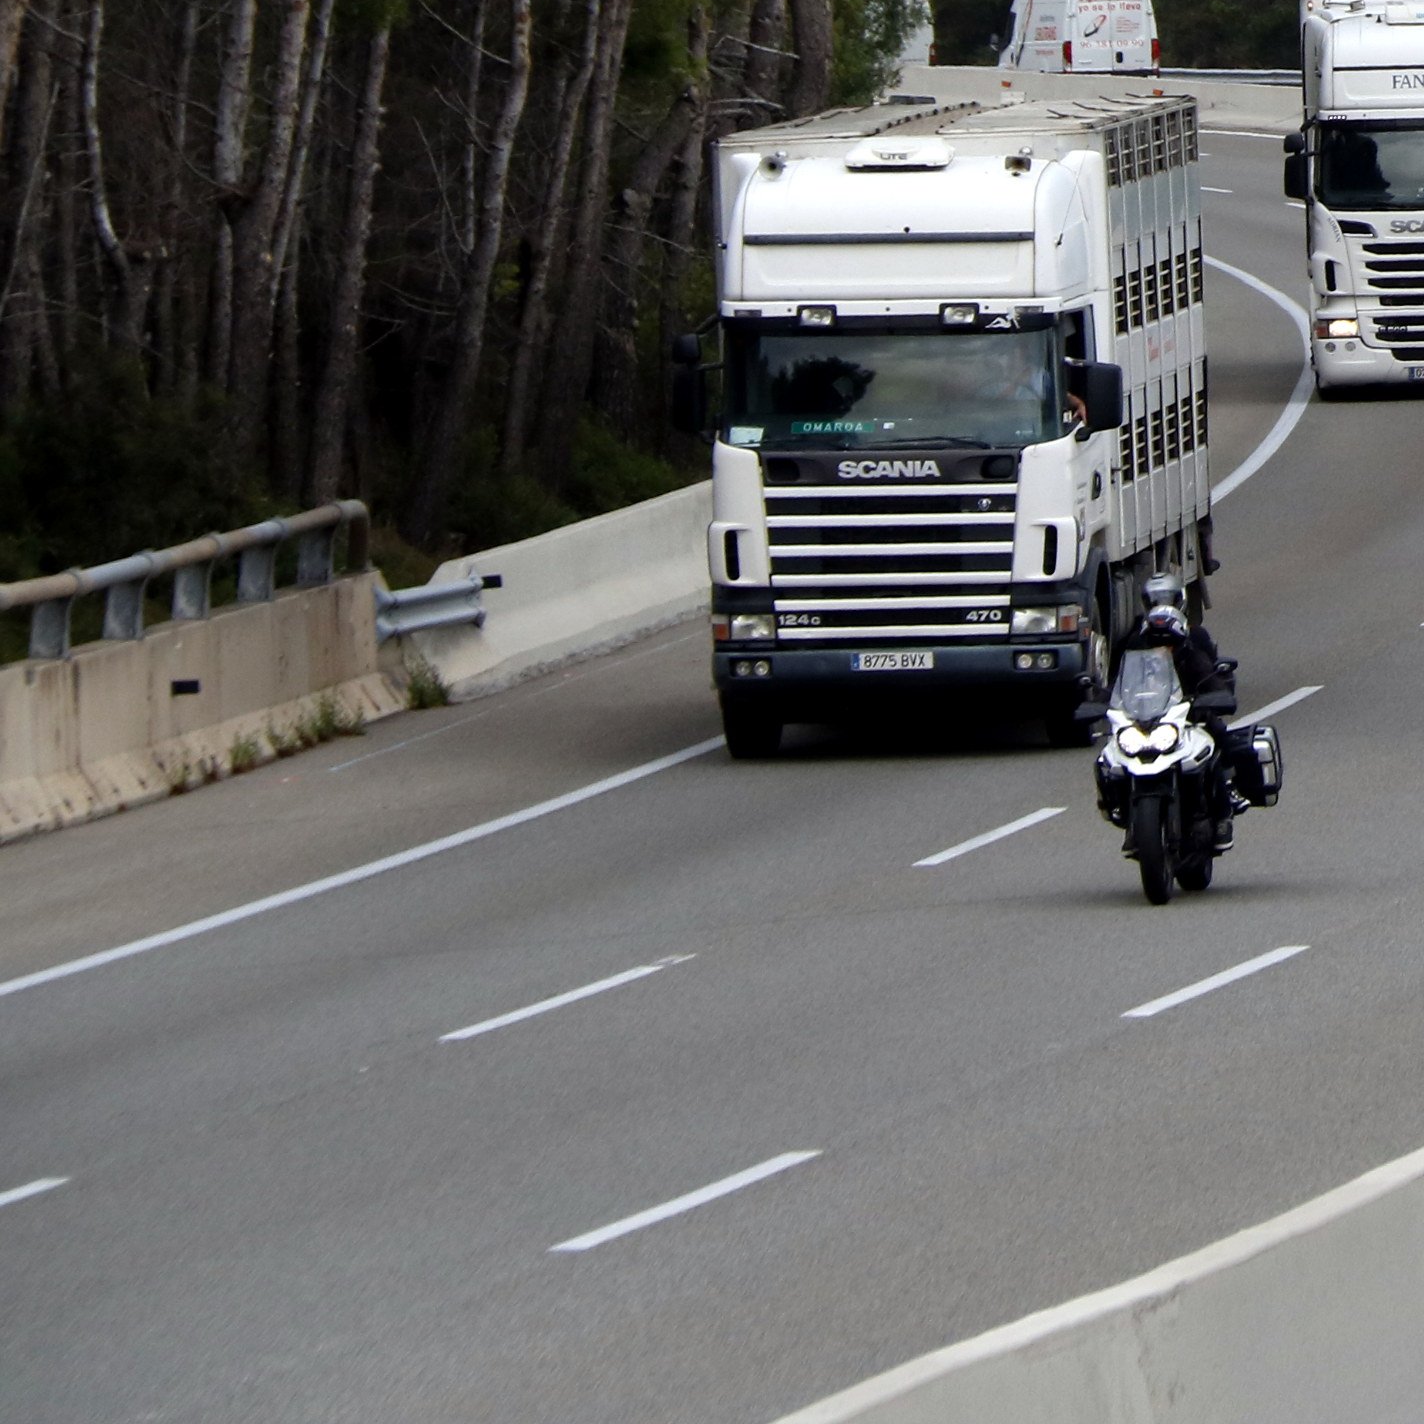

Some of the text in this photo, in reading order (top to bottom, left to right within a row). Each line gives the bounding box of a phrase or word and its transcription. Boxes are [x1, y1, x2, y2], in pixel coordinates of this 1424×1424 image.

[837, 460, 941, 479] SCANIA
[966, 609, 1002, 622] 470
[863, 653, 926, 668] 8775 BVX
